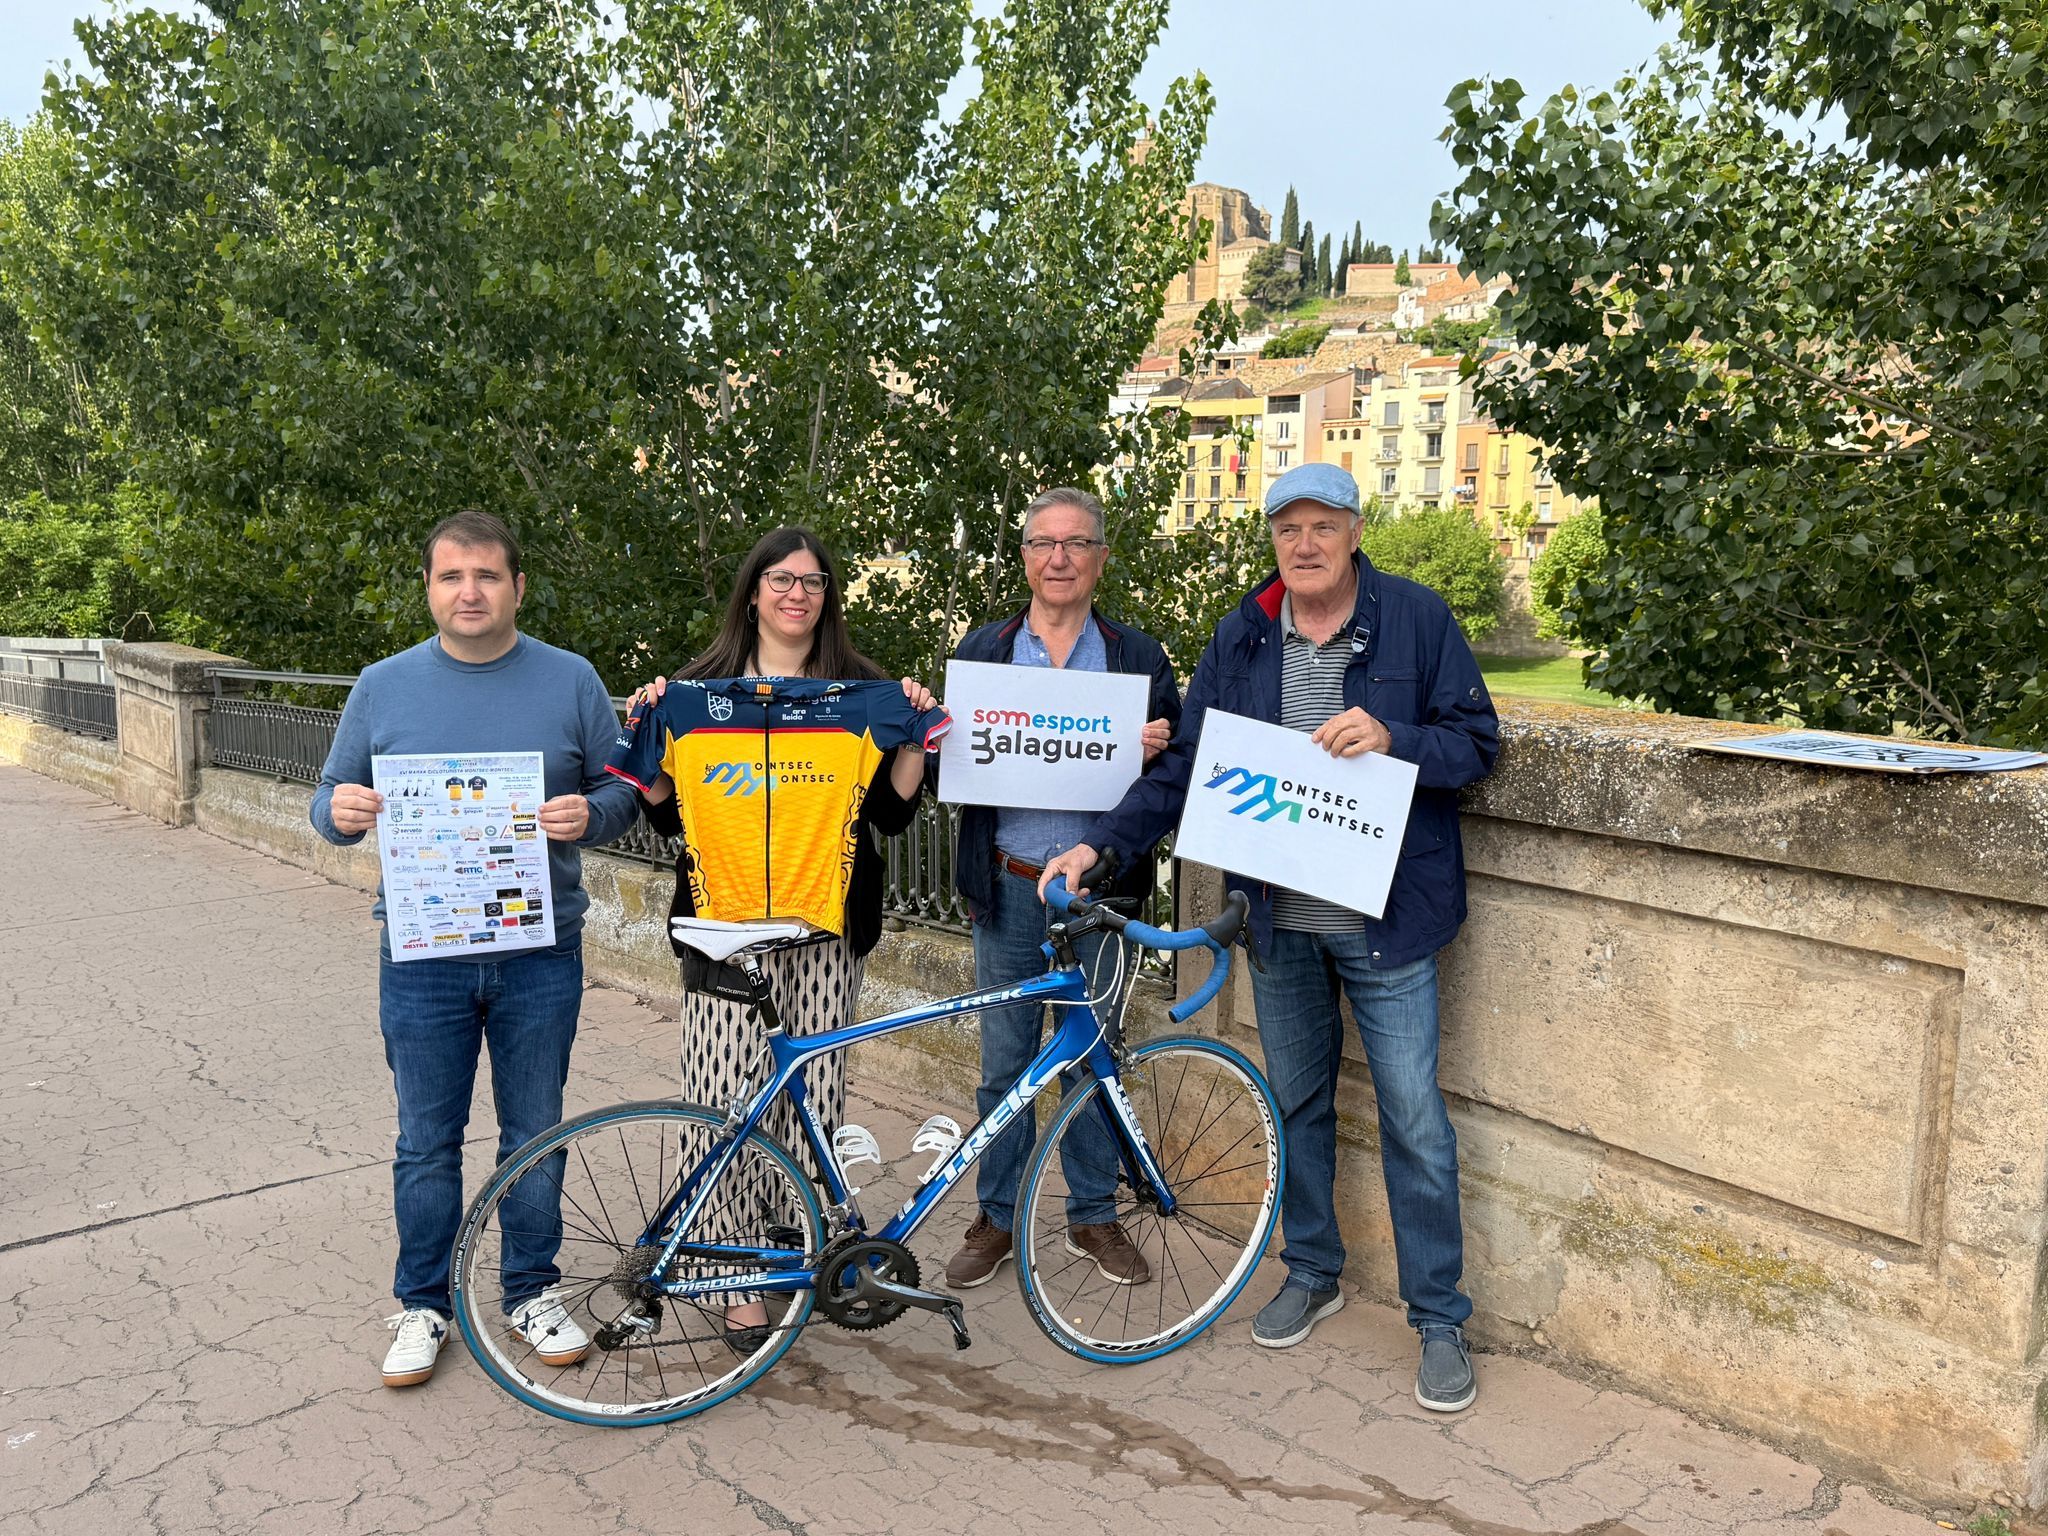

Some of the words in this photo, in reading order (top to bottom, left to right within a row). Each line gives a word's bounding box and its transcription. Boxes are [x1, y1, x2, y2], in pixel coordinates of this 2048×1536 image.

[972, 707, 1112, 735] somesport
[940, 988, 1024, 1010] TREK
[935, 1068, 1043, 1185] TREK
[1115, 1083, 1148, 1149] TREK
[1246, 1081, 1277, 1212] BONTRAGER
[651, 1226, 686, 1277] TREK
